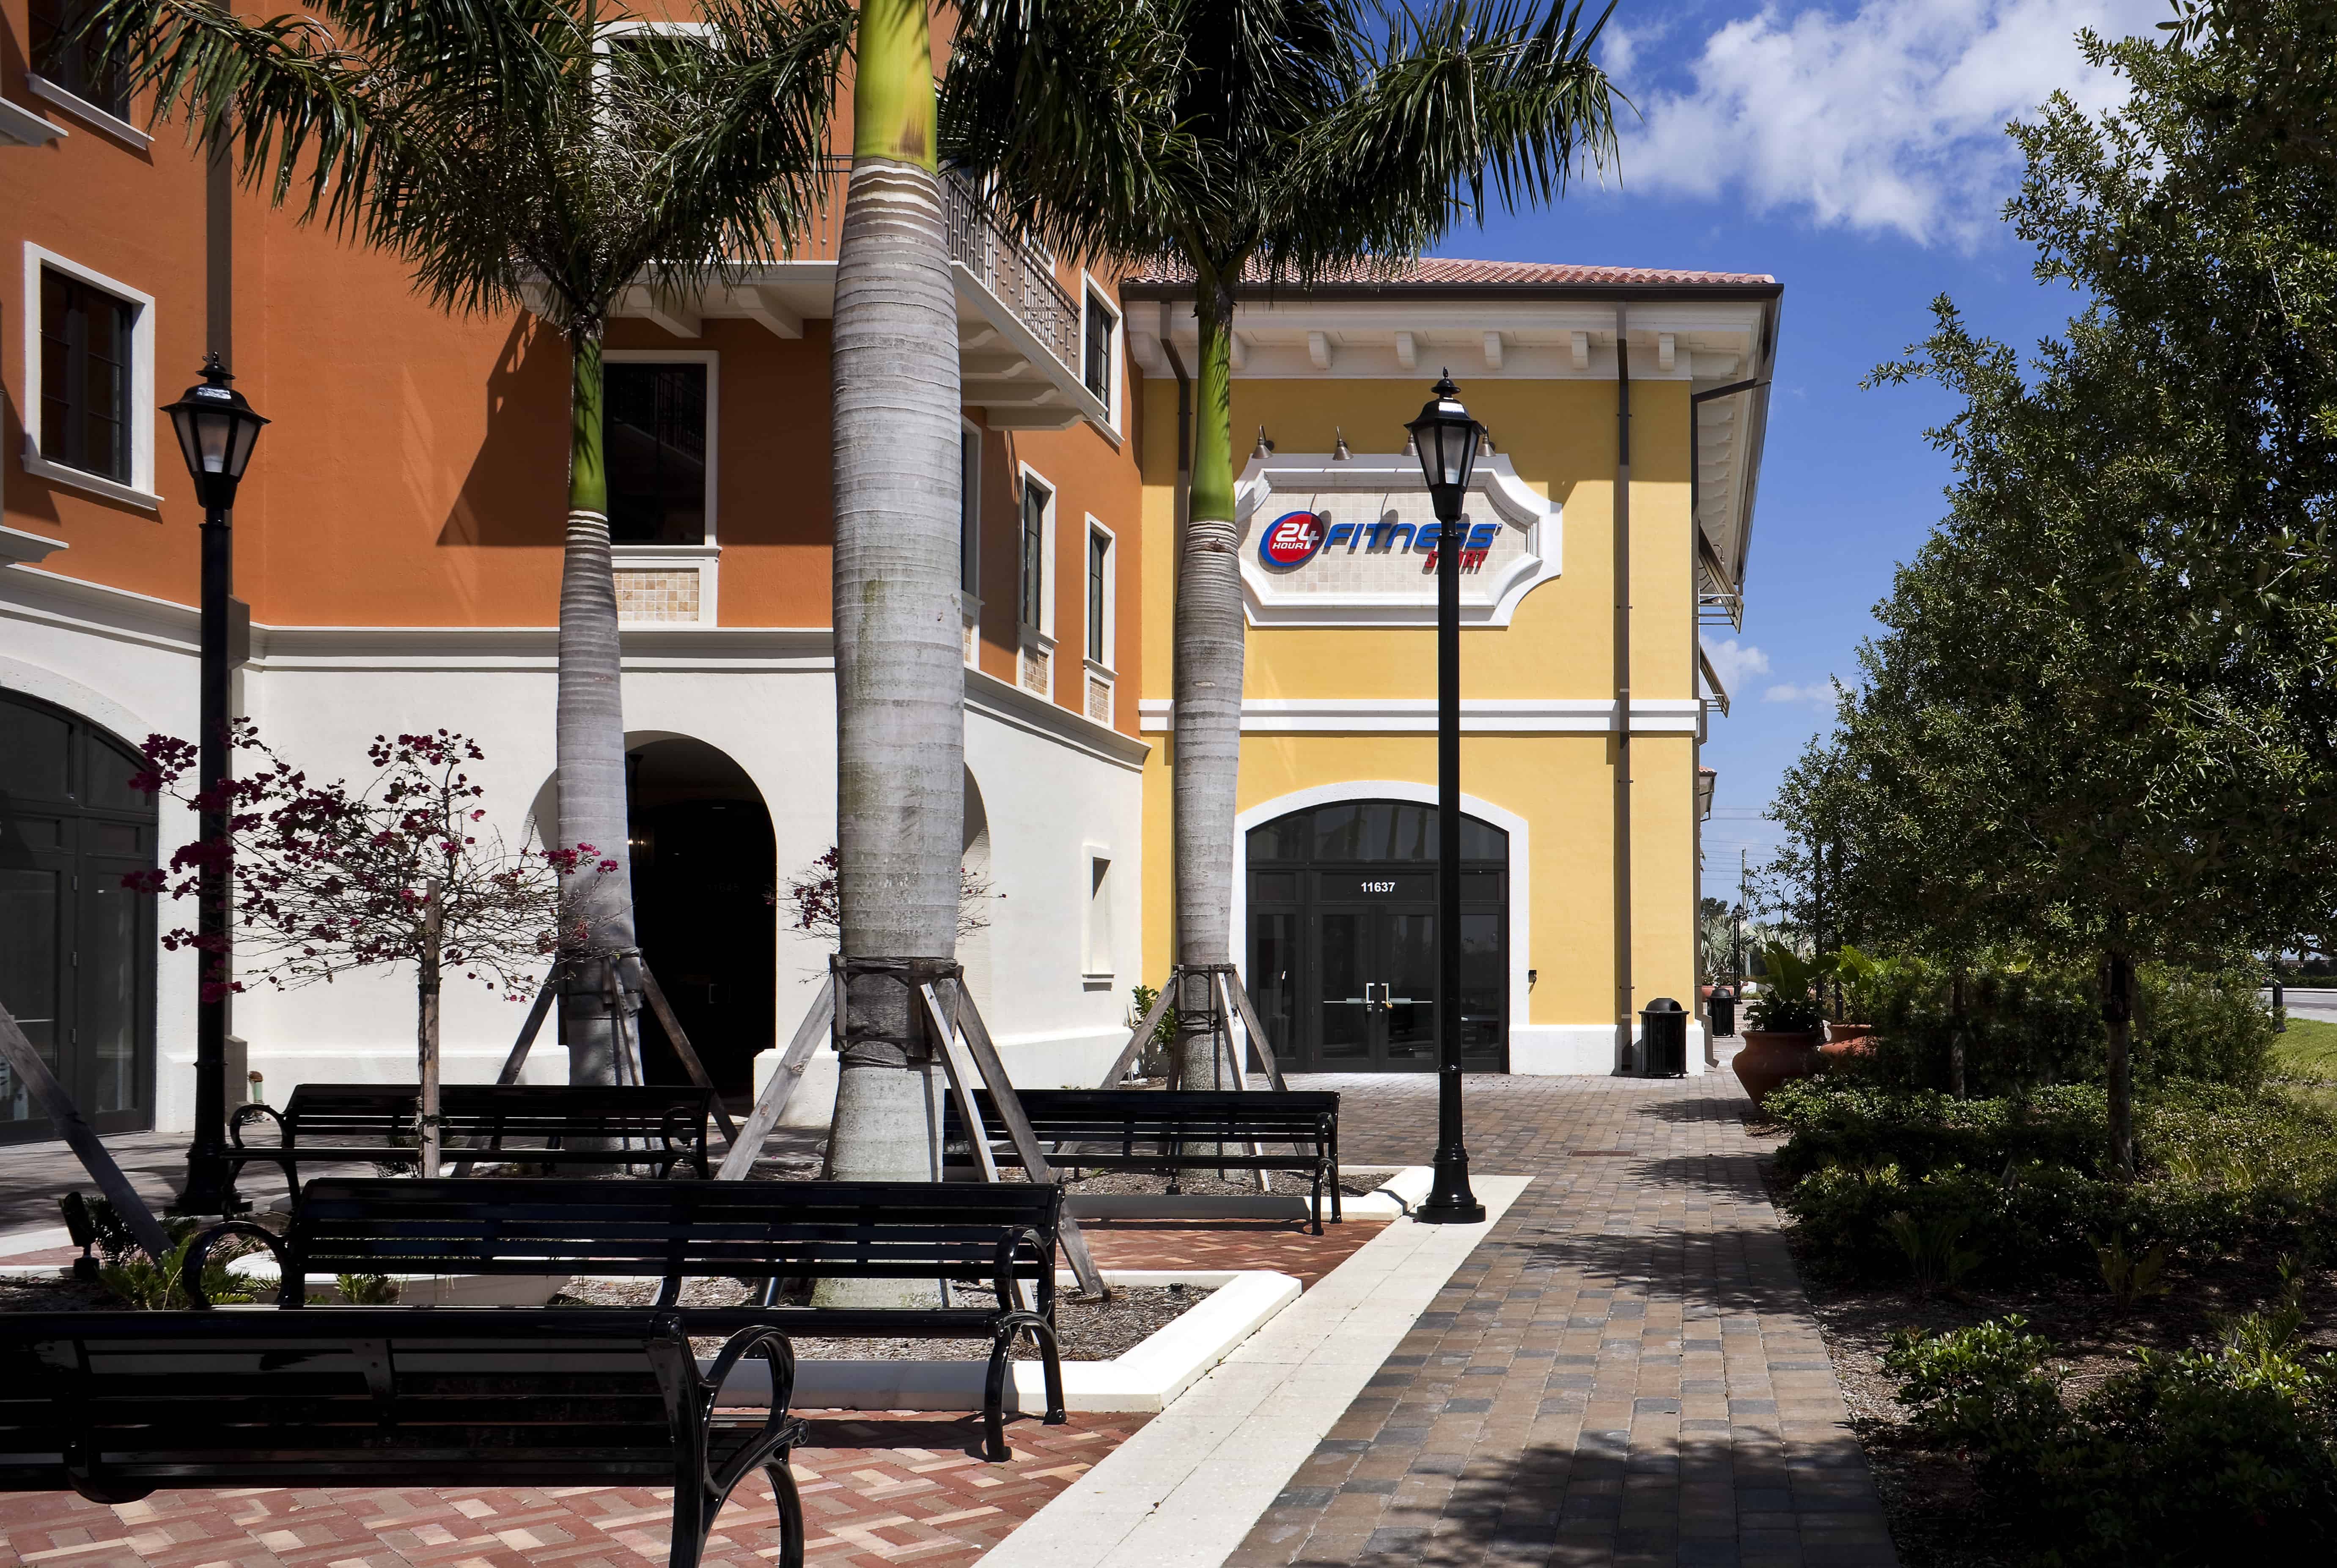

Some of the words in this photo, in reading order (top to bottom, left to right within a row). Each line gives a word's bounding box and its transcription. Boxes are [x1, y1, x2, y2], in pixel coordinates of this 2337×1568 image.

[1275, 523, 1319, 549] 24
[1424, 551, 1488, 568] SRT
[1361, 882, 1395, 892] 11637
